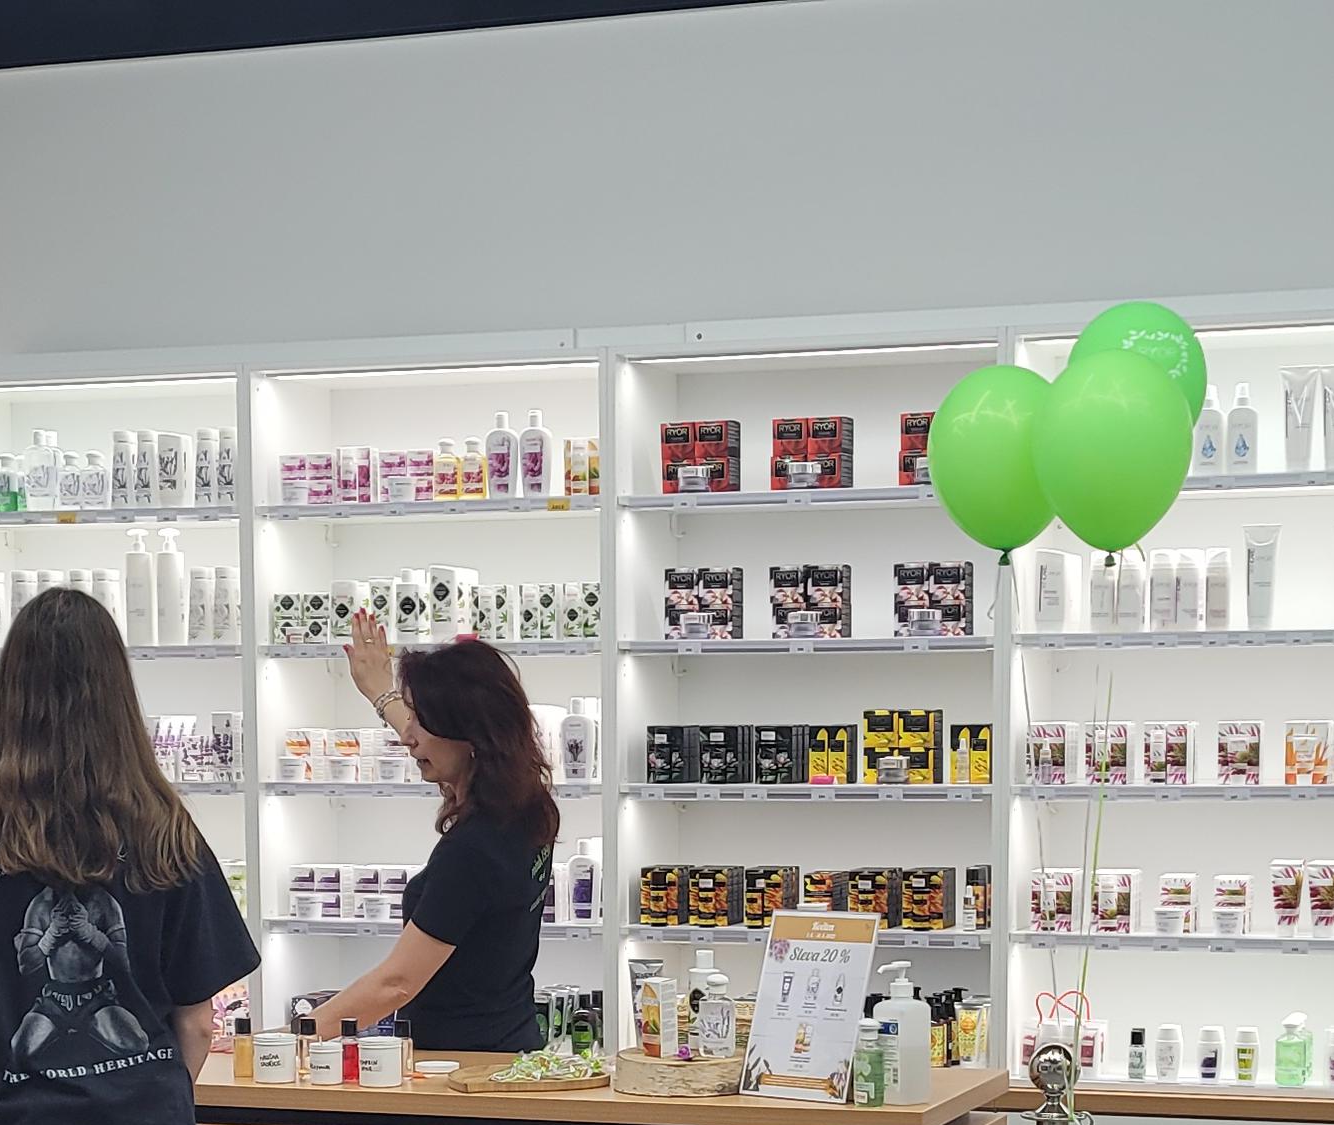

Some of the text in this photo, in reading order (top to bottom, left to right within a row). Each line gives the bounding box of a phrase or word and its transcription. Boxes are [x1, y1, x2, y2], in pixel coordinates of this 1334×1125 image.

[813, 421, 836, 432] RYOR
[906, 417, 928, 428] RYOR
[667, 426, 688, 437] RYOR
[699, 424, 722, 435] RYOR
[778, 423, 801, 433] RYOR
[705, 573, 726, 582] RYOR
[776, 571, 797, 580] RYOR
[814, 571, 835, 580] RYOR
[899, 569, 922, 578] RYOR
[936, 568, 958, 577] RYOR
[670, 574, 692, 582] RYOR
[790, 946, 851, 964] Sleva 20 %
[40, 1066, 87, 1080] ORLD
[93, 1047, 174, 1075] HERITAGE
